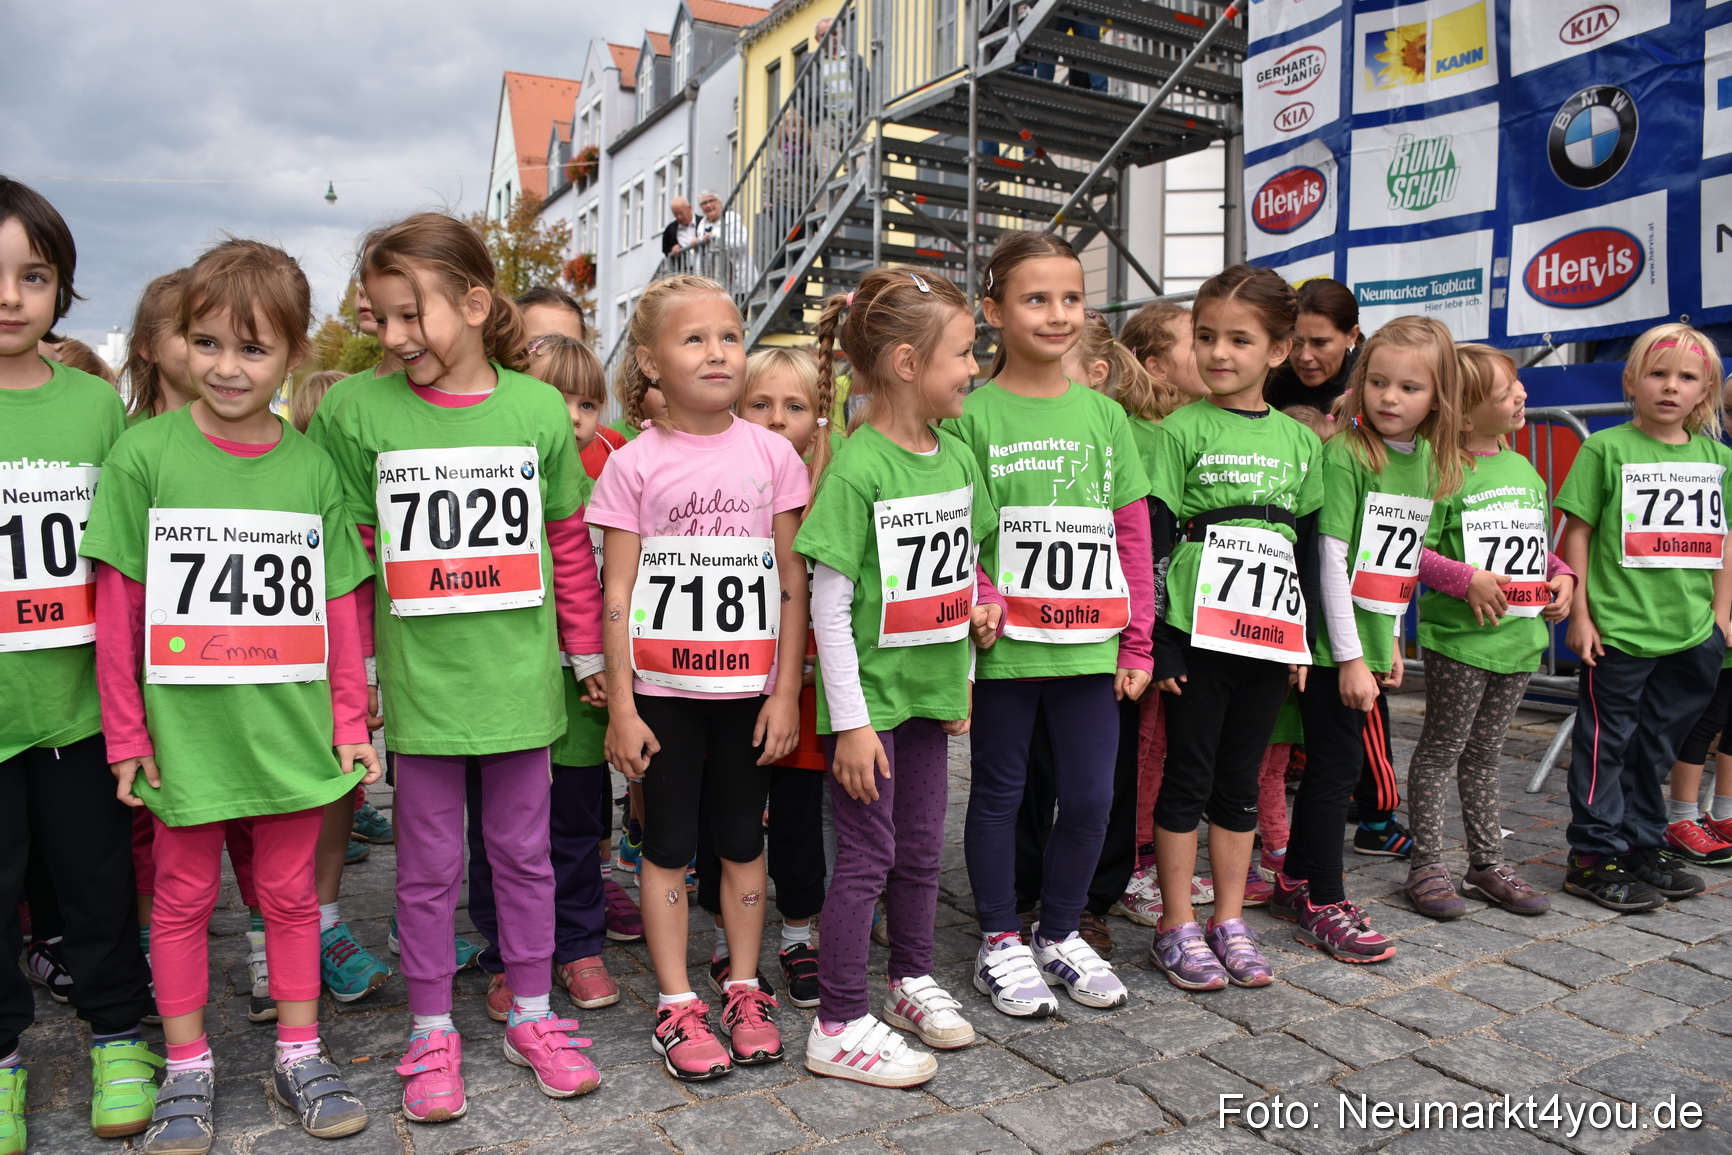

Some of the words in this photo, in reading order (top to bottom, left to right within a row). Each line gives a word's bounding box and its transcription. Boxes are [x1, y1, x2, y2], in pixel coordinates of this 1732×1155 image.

[1570, 12, 1609, 39] KIA
[1256, 54, 1314, 83] GERHART
[1435, 47, 1484, 73] KANN
[1284, 63, 1321, 87] JANIG
[1282, 107, 1308, 127] KIA
[1554, 88, 1629, 131] BMW
[1390, 133, 1453, 176] RUND
[1260, 179, 1321, 219] Hervis
[1388, 166, 1461, 211] SCHAU
[1537, 244, 1634, 288] Hervis
[1359, 284, 1428, 302] Neumarkter
[1430, 276, 1477, 296] Tagblatt
[1546, 283, 1593, 297] SPORTS
[1424, 303, 1443, 312] Hier
[1445, 300, 1463, 309] lebe
[989, 437, 1081, 458] Neumarkter
[990, 455, 1065, 478] Stadtlauf
[1197, 453, 1280, 468] Neumarkter
[379, 466, 430, 485] PARTL
[435, 464, 515, 480] Neumarkt
[1625, 473, 1667, 484] PARTL
[1669, 473, 1716, 484] Neumarkt
[3, 486, 91, 505] Neumarkt
[669, 488, 750, 523] adidas
[390, 487, 529, 551] 7029
[1368, 504, 1406, 520] PARTL
[1636, 488, 1721, 528] 7219
[880, 512, 934, 530] PARTL
[1003, 520, 1051, 533] PARTL
[1055, 520, 1106, 535] Neumarkt
[1466, 521, 1508, 532] PARTL
[155, 526, 218, 542] PARTL
[223, 527, 302, 545] Neumarkt
[529, 540, 535, 550] K
[1208, 538, 1254, 553] PARTL
[1652, 537, 1712, 553] Johanna
[386, 549, 391, 560] 1
[642, 552, 686, 566] PARTL
[690, 553, 759, 567] Neumarkt
[1016, 541, 1113, 591] 7077
[170, 553, 314, 616] 7438
[429, 564, 501, 591] Anouk
[1216, 556, 1300, 616] 7175
[17, 599, 64, 624] Eva
[649, 575, 767, 633] 7181
[936, 597, 968, 624] Julia
[1041, 604, 1100, 628] Sophia
[315, 612, 320, 622] K
[635, 626, 641, 636] 1
[1230, 618, 1284, 644] Juanita
[200, 634, 278, 662] Emma
[672, 648, 749, 670] Madlen
